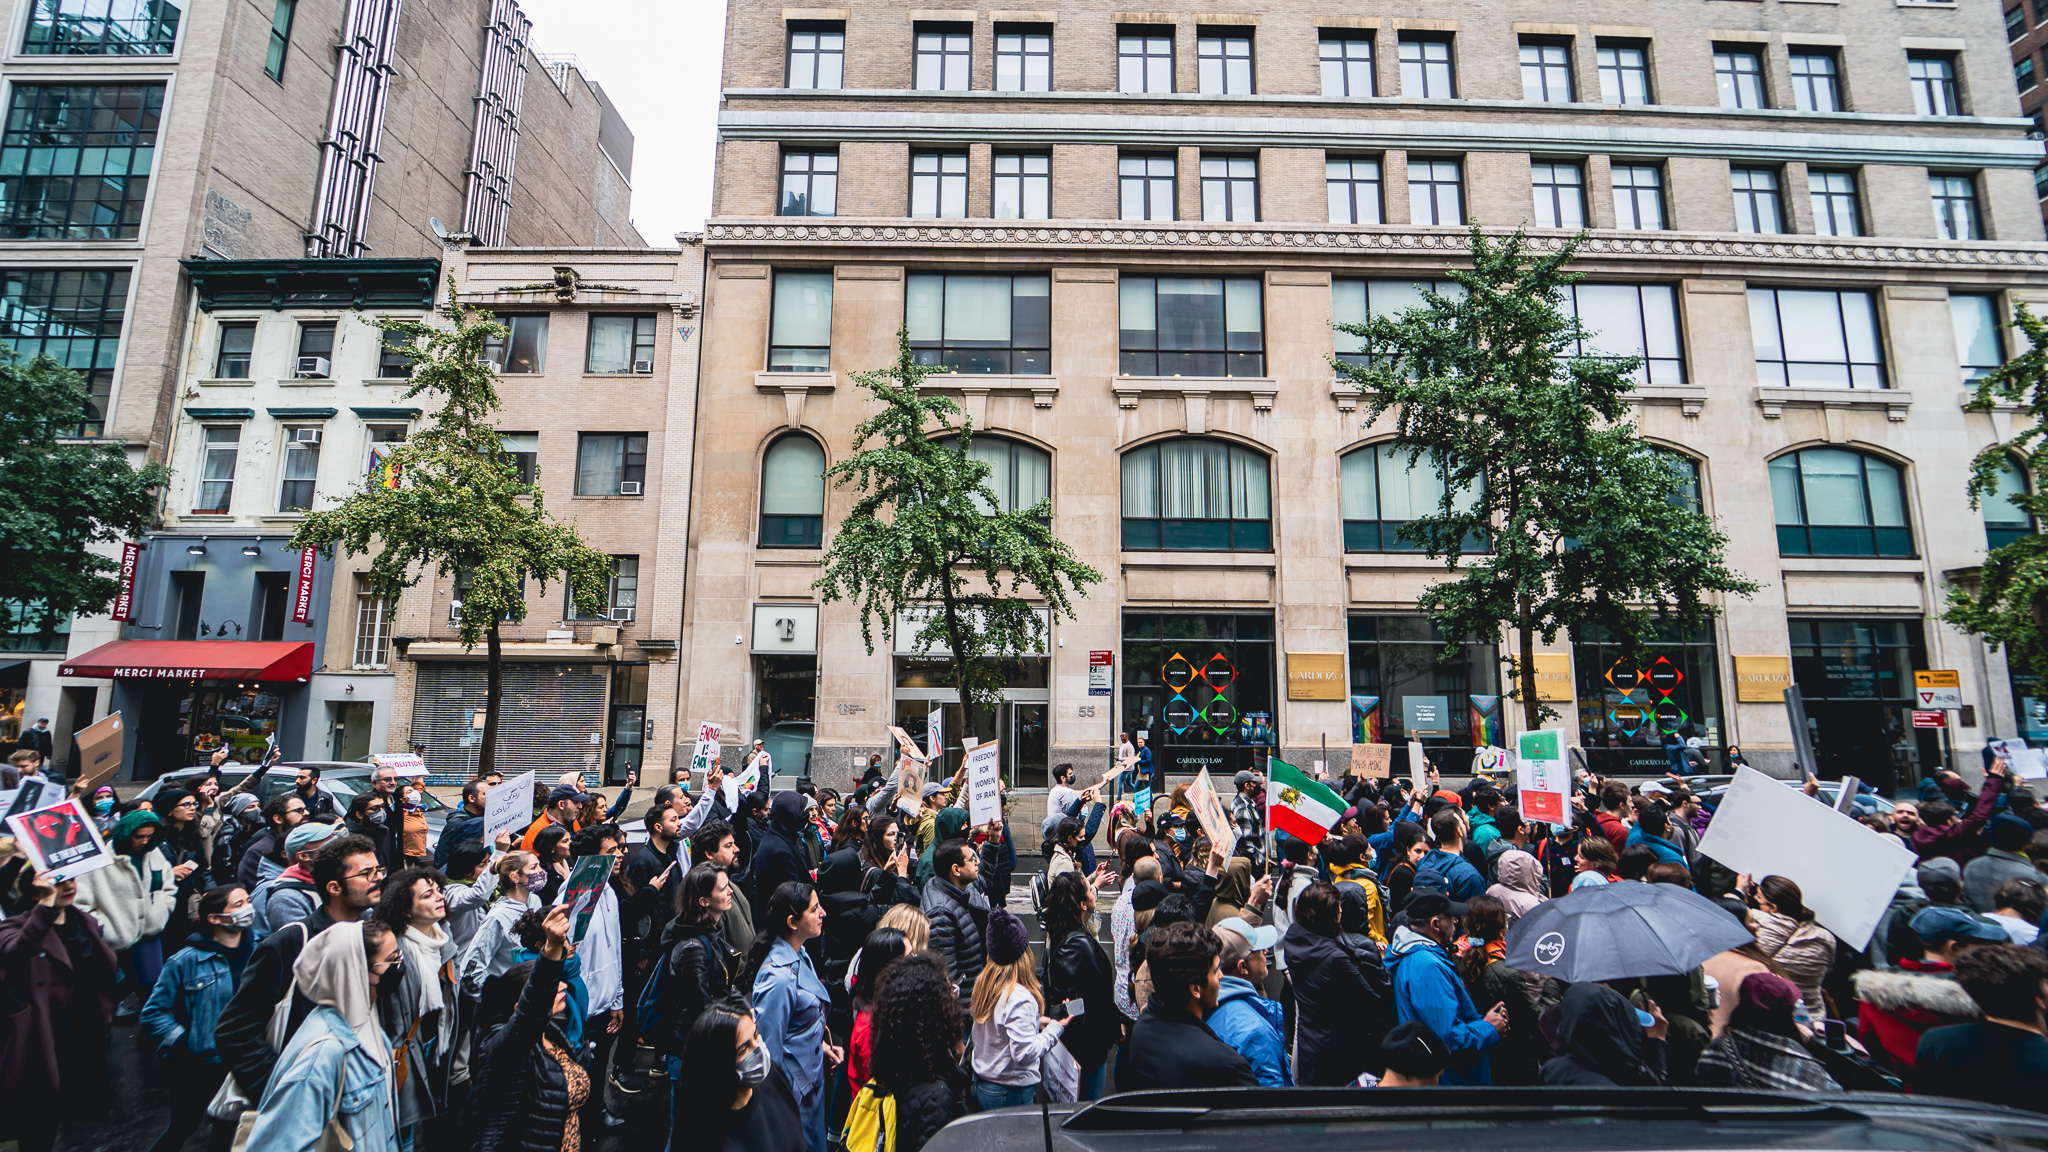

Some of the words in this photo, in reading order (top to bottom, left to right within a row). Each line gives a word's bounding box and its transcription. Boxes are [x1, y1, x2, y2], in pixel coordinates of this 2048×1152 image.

[302, 547, 313, 578] MERCI
[297, 580, 310, 619] MARKET
[113, 668, 153, 677] MERCI
[156, 669, 206, 678] MARKET
[1290, 671, 1344, 680] CARDOZO
[1738, 673, 1790, 683] CARDOZO
[1078, 706, 1096, 718] 55
[972, 750, 997, 763] FREEDOM
[979, 765, 989, 774] FOR
[974, 777, 996, 788] WOMEN
[975, 792, 983, 801] OF
[983, 790, 996, 799] IRAN
